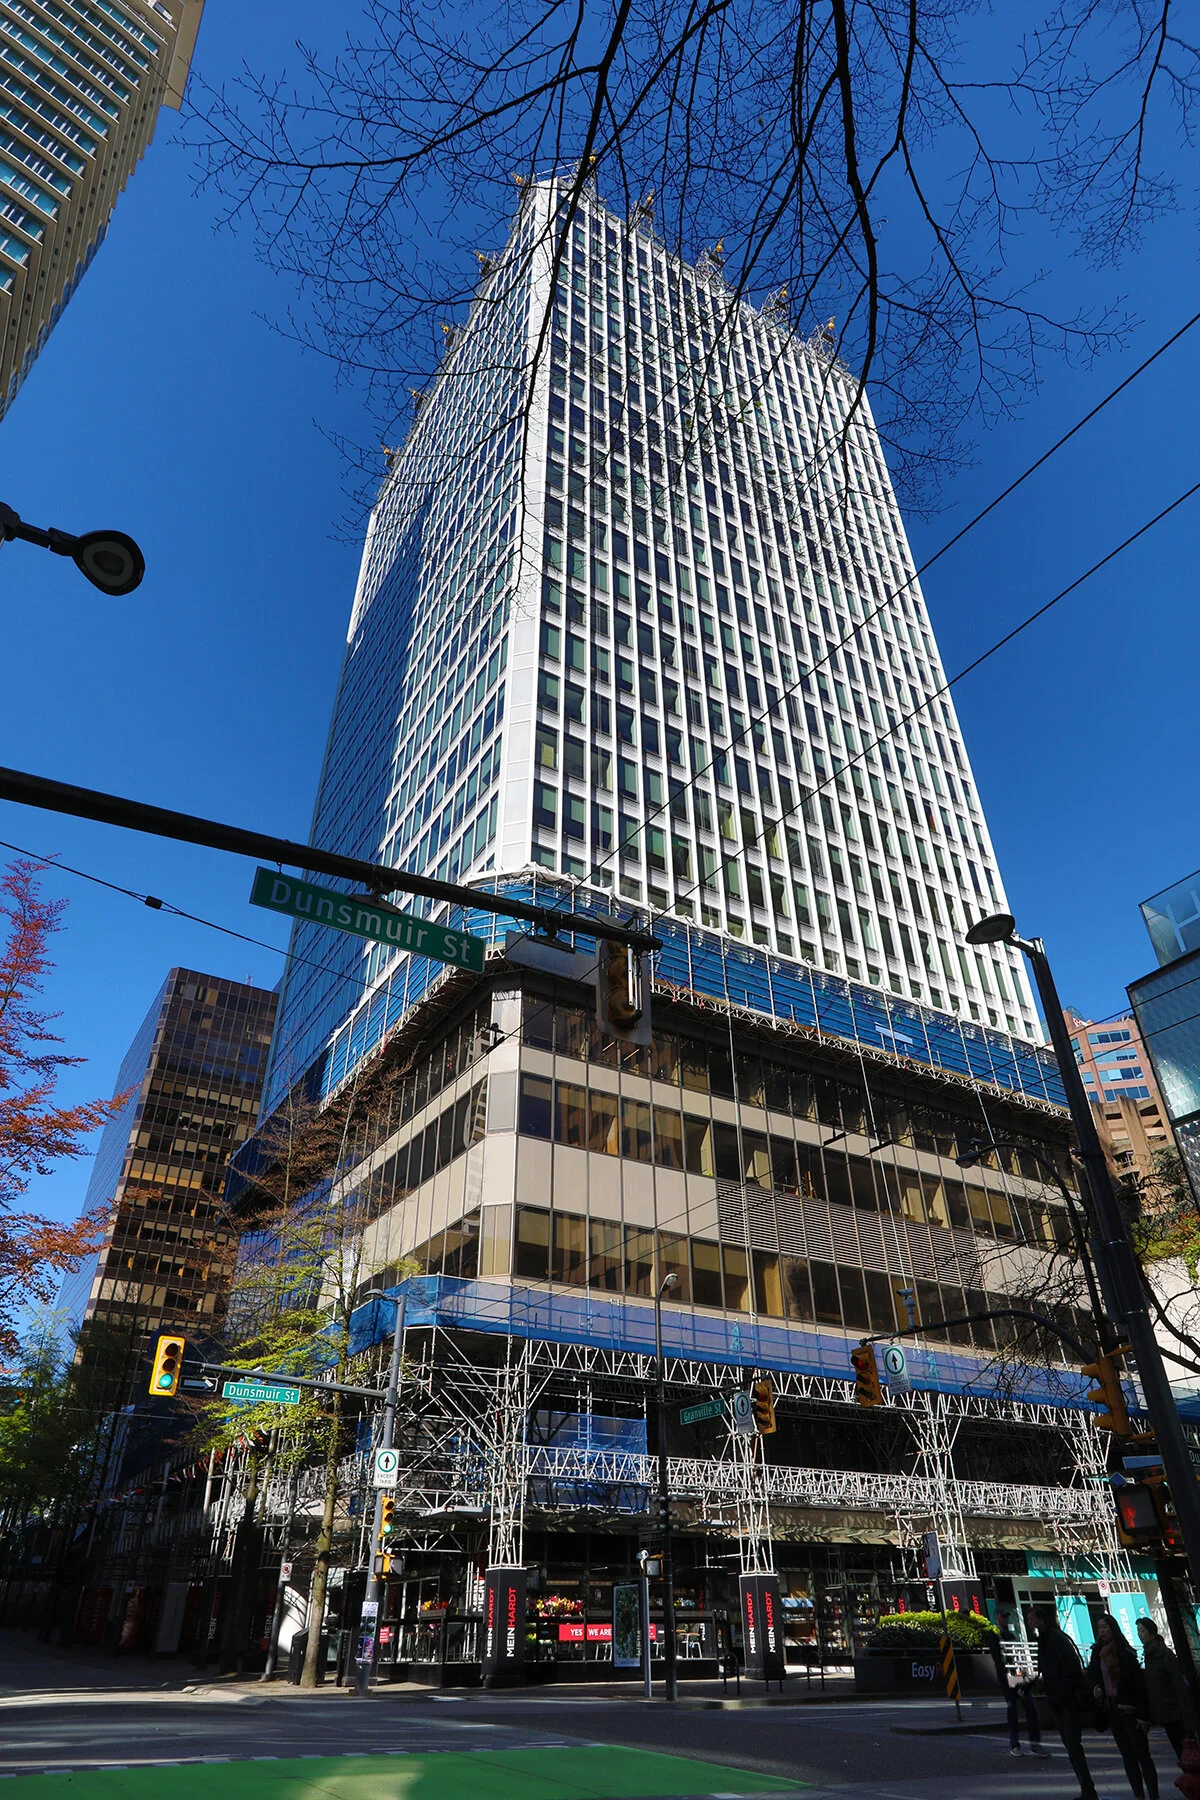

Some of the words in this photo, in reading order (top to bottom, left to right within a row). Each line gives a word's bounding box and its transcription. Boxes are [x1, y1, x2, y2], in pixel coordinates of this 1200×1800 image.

[271, 879, 428, 948] Dunsmuir
[442, 933, 470, 963] St
[229, 1385, 281, 1400] Dunsmuir
[284, 1390, 295, 1401] St
[683, 1406, 712, 1422] Granville
[715, 1402, 722, 1414] St
[486, 1587, 495, 1658] MEINHARDT
[506, 1587, 517, 1658] MEINHARDT
[570, 1628, 583, 1636] YES
[588, 1628, 599, 1636] WE
[600, 1628, 612, 1636] ARE
[746, 1591, 757, 1654] MEINHARDT
[764, 1591, 776, 1654] MEINHARDT
